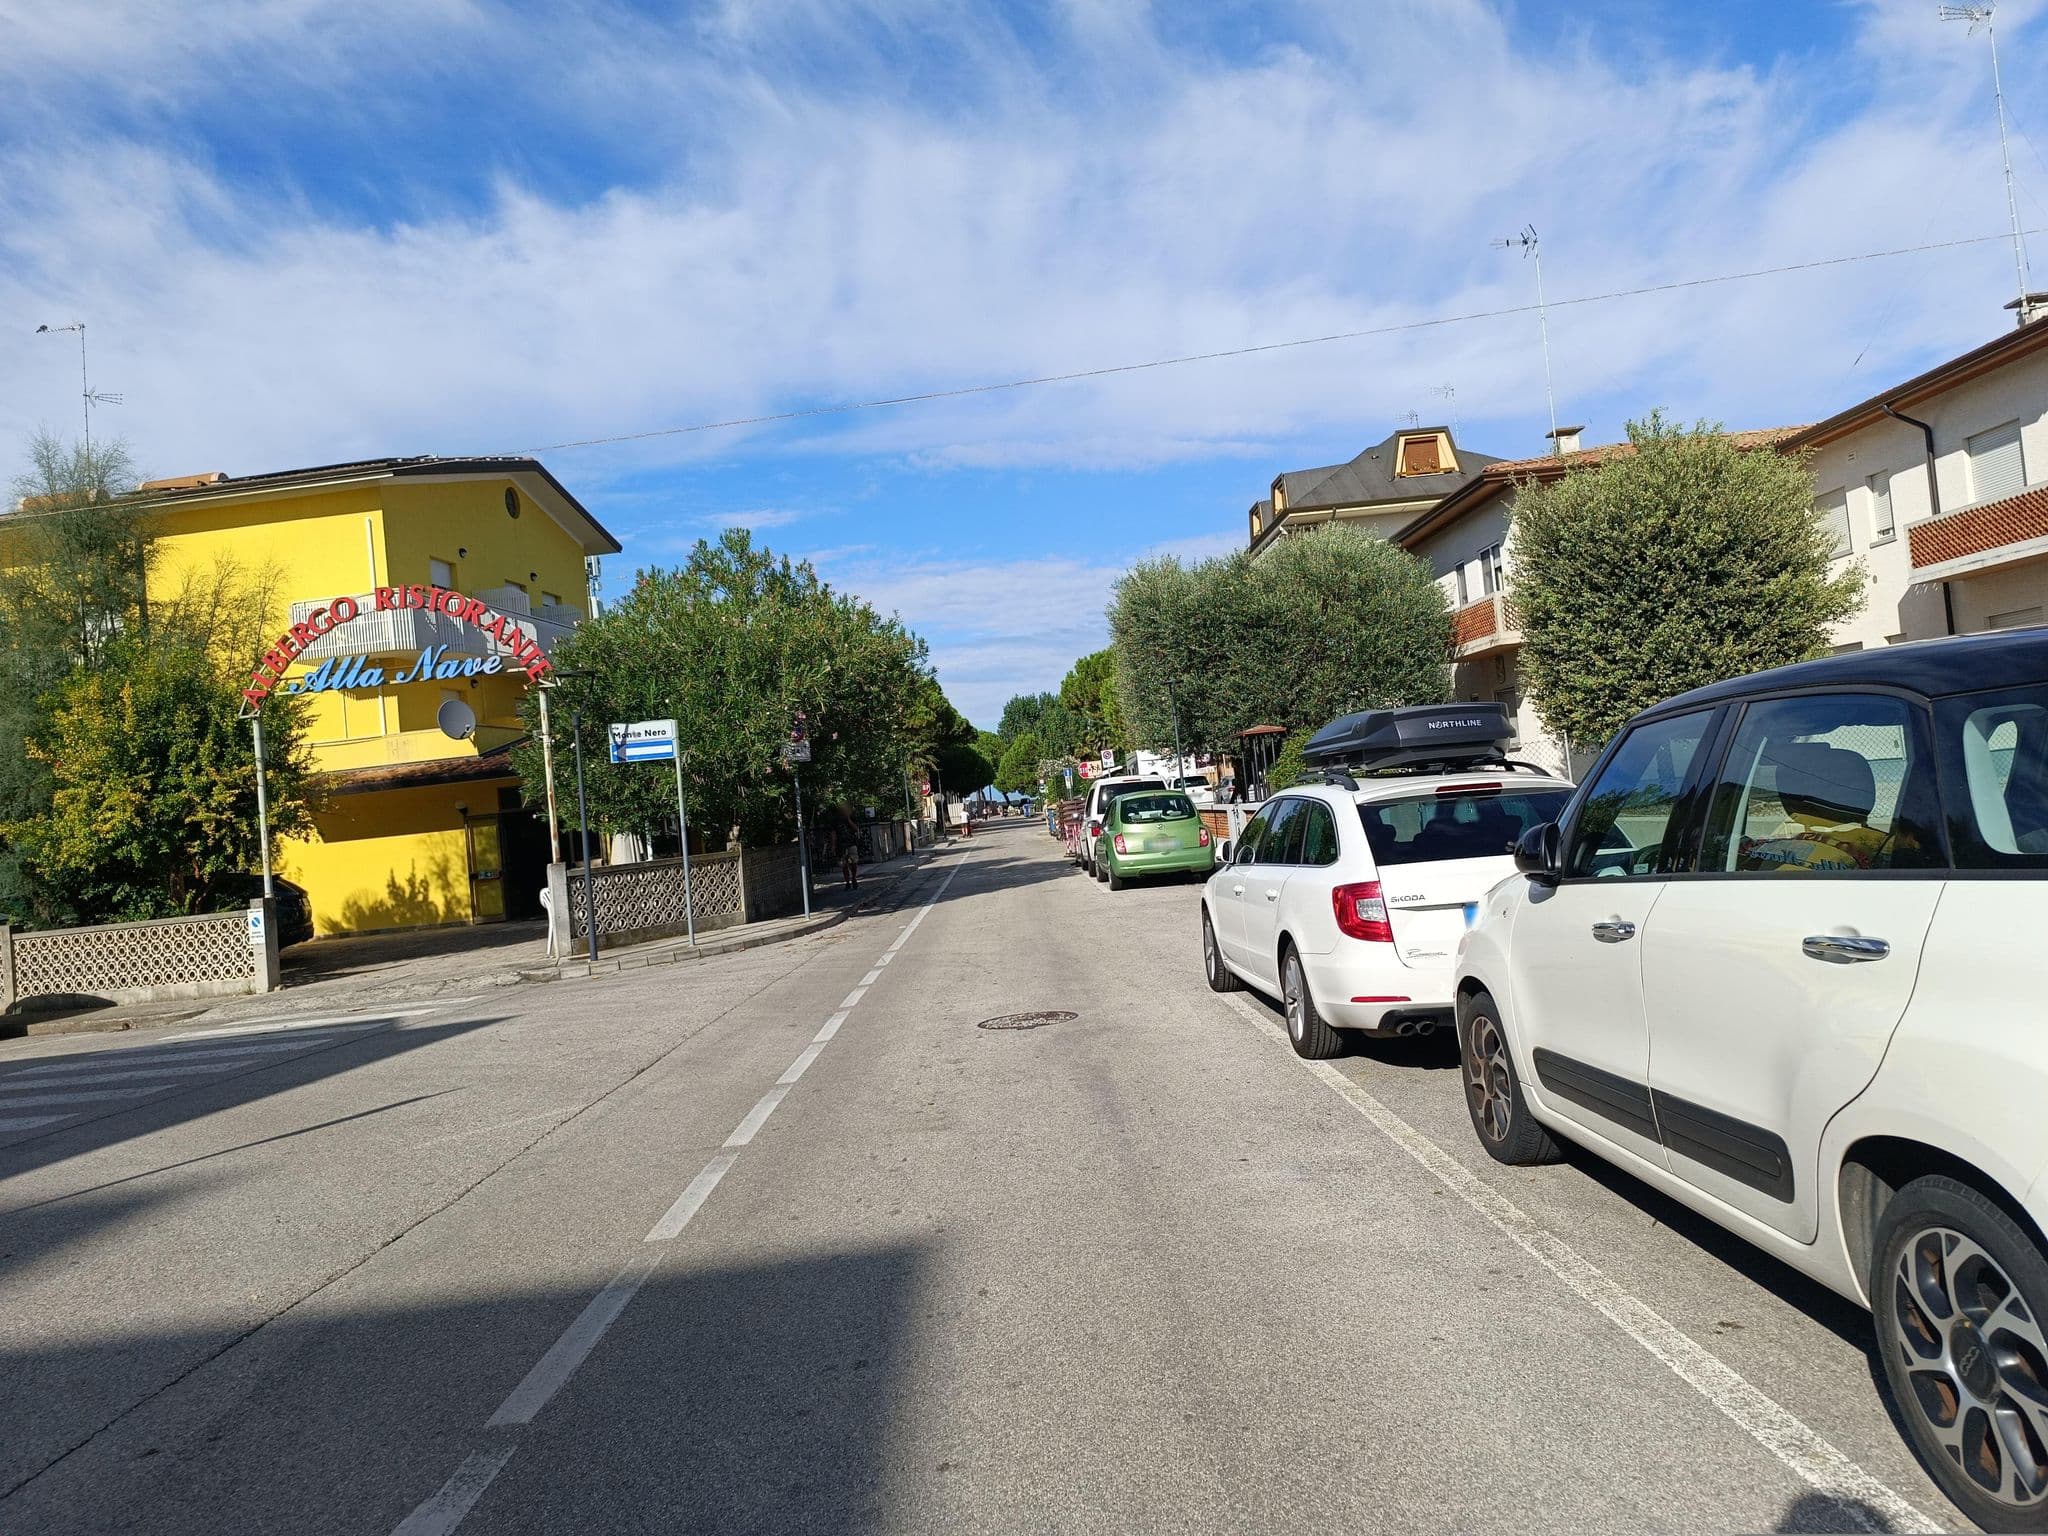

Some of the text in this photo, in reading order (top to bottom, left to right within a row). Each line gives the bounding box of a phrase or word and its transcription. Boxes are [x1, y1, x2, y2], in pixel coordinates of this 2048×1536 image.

[241, 584, 554, 710] ALBERGO RISTORANTE
[288, 643, 503, 695] Alla Nave
[613, 729, 667, 739] Monte Nero
[1428, 719, 1482, 730] NORTHLINE
